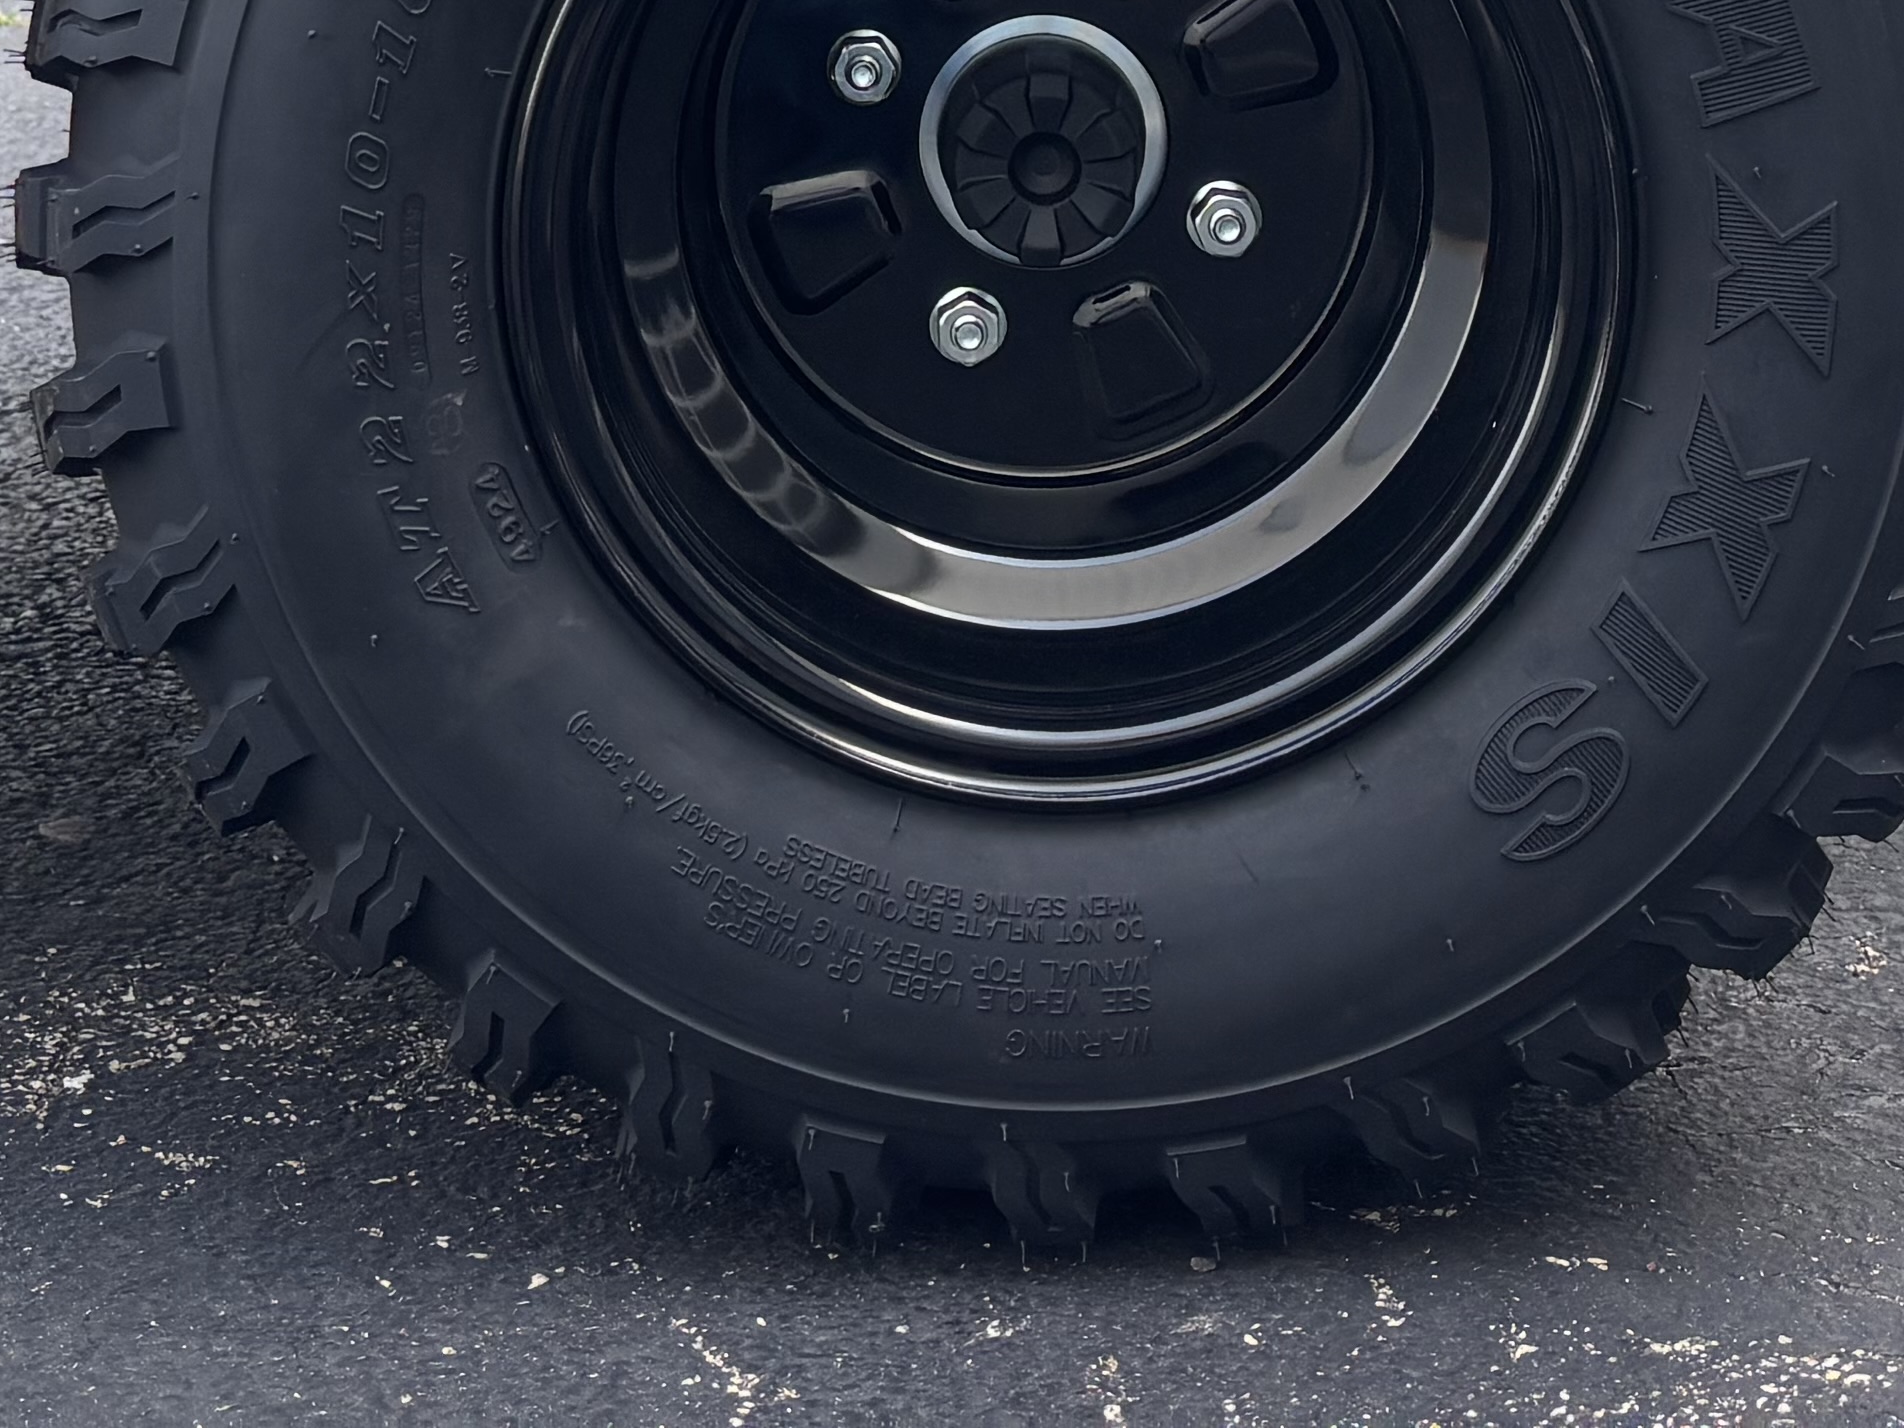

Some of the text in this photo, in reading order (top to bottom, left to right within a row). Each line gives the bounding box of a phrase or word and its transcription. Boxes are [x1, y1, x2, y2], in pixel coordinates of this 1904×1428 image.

[779, 833, 1139, 918] WHEN SEATING BEAD TUBELESS
[799, 868, 847, 904] 250
[849, 887, 943, 932] BEYOND
[950, 911, 1043, 942] INFLATE
[1055, 916, 1100, 944] NOT
[1112, 913, 1144, 941] DO
[808, 914, 954, 975] OPERATING
[971, 954, 1024, 983] FOR
[1041, 951, 1150, 985] MANUAL
[884, 968, 963, 1006] LABEL
[975, 983, 1080, 1016] VEHICLE
[1100, 983, 1153, 1014] SEE
[1003, 1020, 1155, 1060] WARNING
